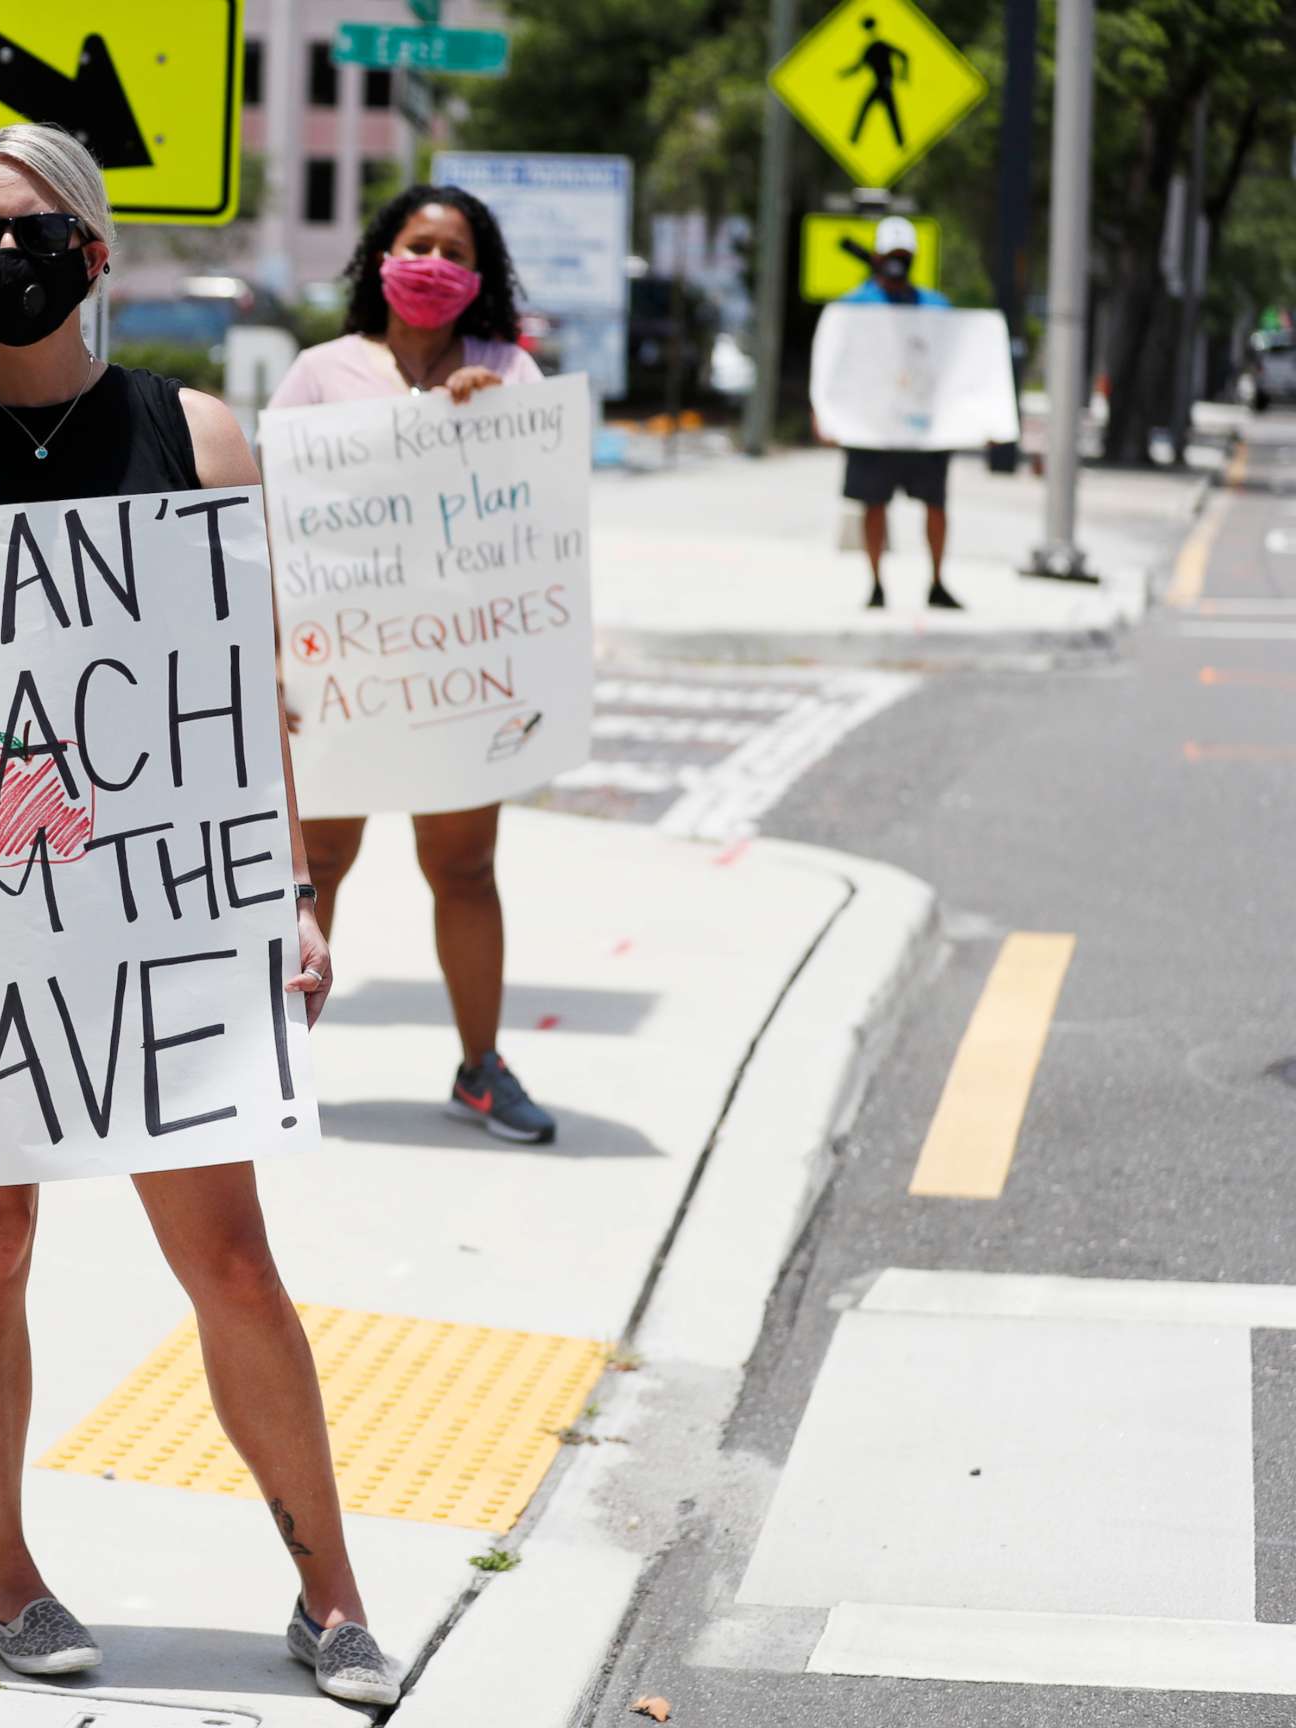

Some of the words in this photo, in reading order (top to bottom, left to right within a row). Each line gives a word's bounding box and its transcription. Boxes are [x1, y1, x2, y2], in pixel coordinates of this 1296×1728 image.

[286, 416, 372, 473] This
[391, 402, 564, 466] Reopening
[282, 493, 414, 543] lesson
[438, 471, 531, 545] plan
[284, 545, 406, 599] should
[435, 522, 544, 579] result
[554, 528, 584, 561] in
[336, 584, 571, 659] REQUIRES
[318, 656, 516, 724] ACTION
[84, 810, 285, 922] THE
